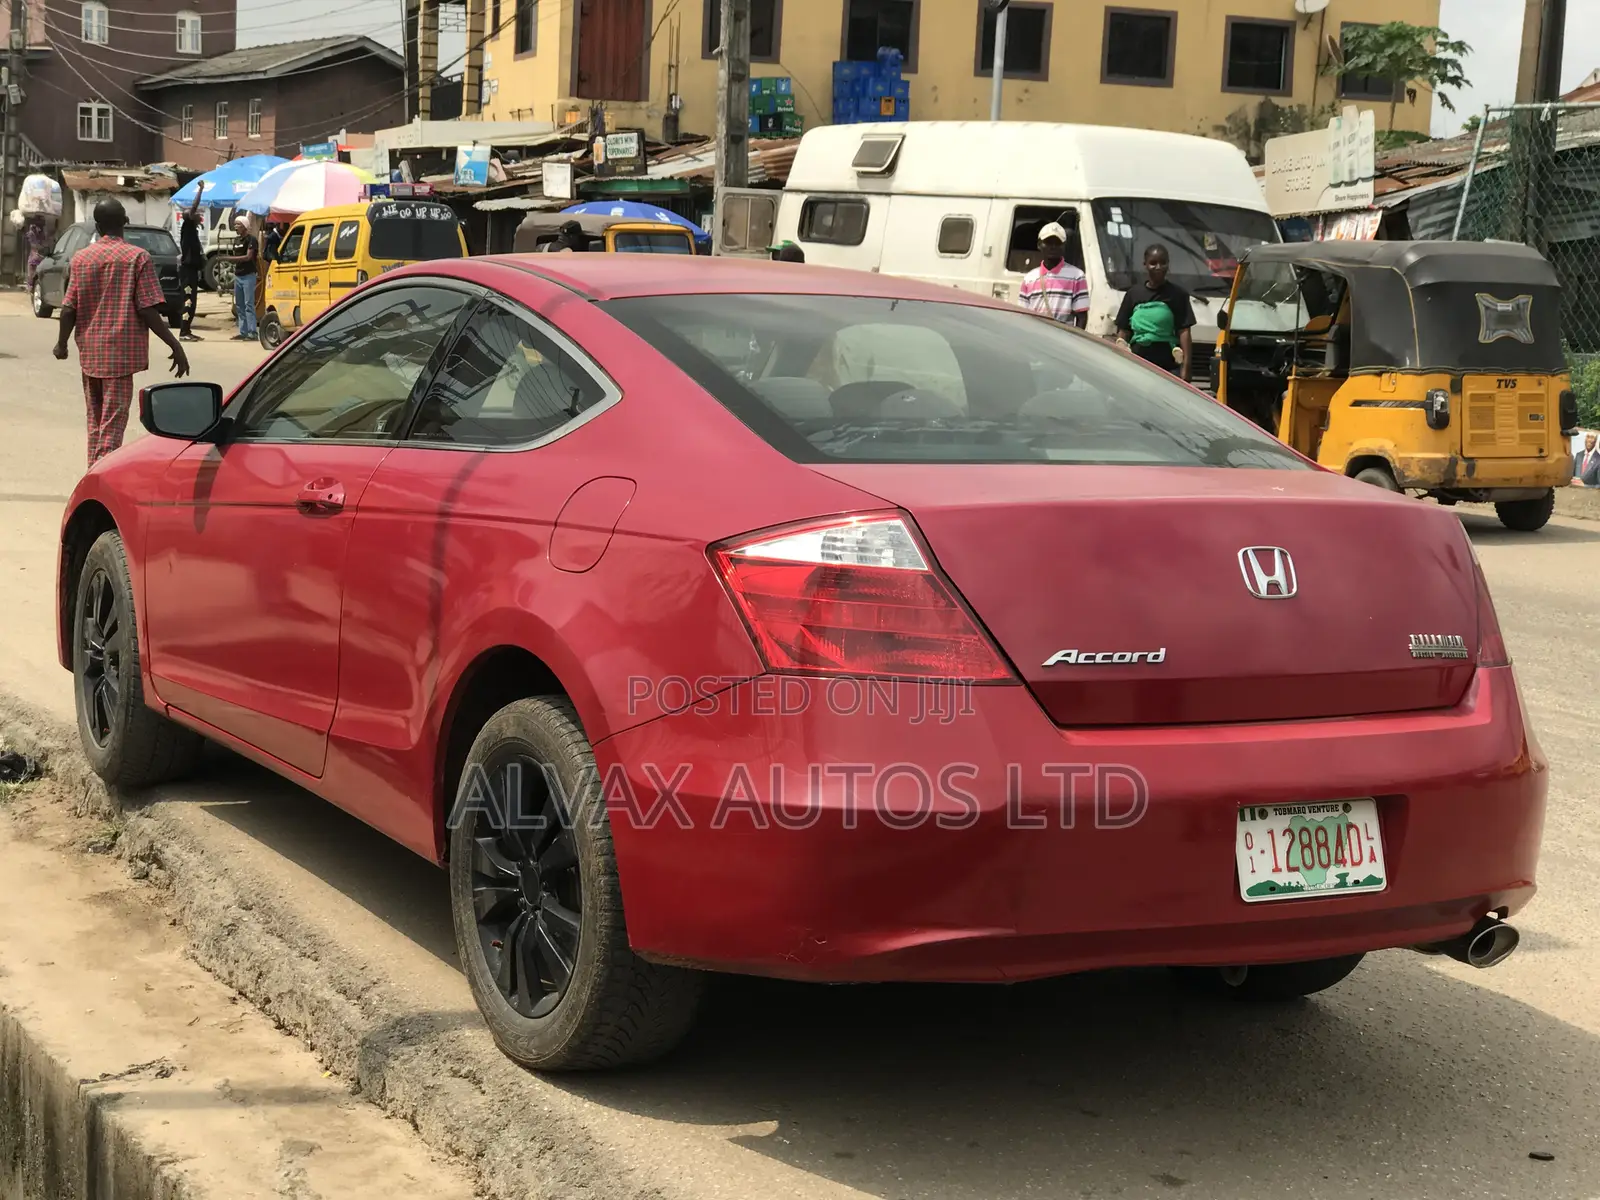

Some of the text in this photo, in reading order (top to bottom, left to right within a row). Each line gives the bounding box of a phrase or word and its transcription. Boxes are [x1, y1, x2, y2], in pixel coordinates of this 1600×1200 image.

[1496, 378, 1518, 389] TVS
[1041, 647, 1166, 666] Accord
[1273, 804, 1340, 816] TOBMARQ VENTURE
